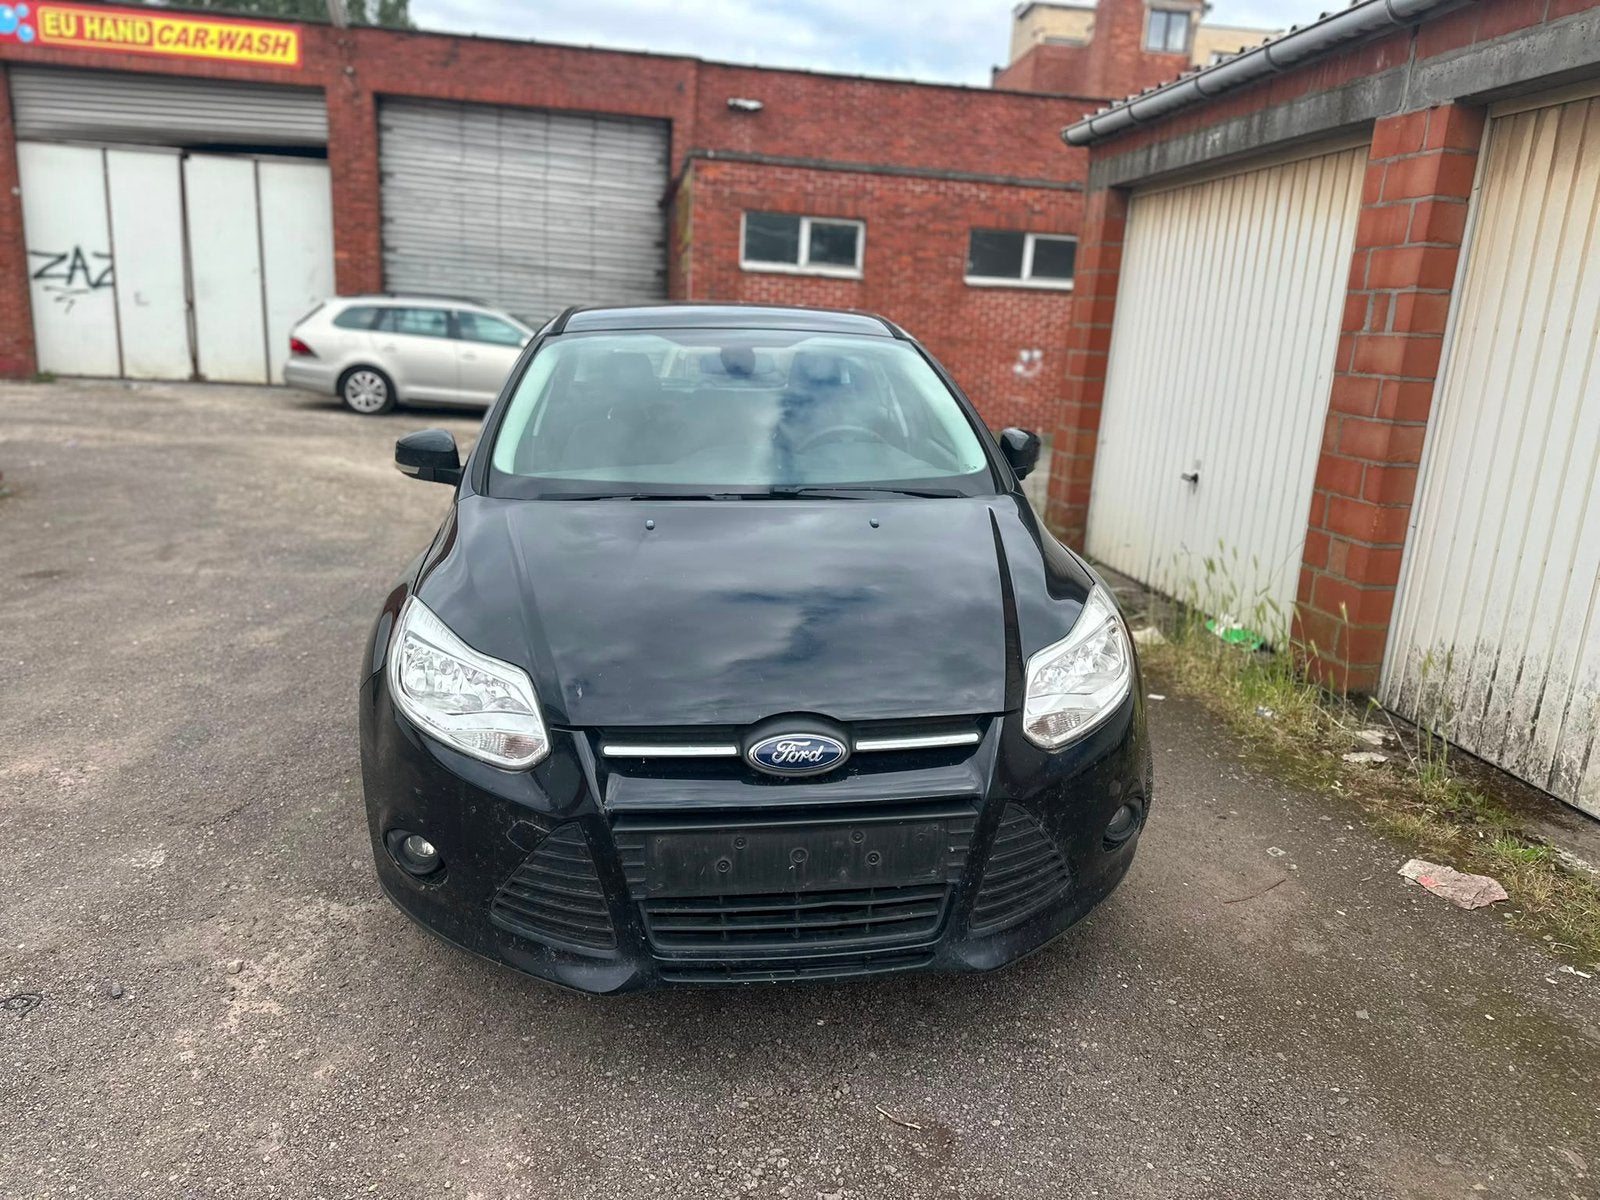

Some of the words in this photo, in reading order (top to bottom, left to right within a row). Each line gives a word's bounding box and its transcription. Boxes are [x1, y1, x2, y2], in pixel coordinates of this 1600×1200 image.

[43, 12, 77, 37] EU
[83, 16, 151, 44] HAND
[157, 24, 292, 57] CAR-WASH
[771, 740, 825, 764] Ford
